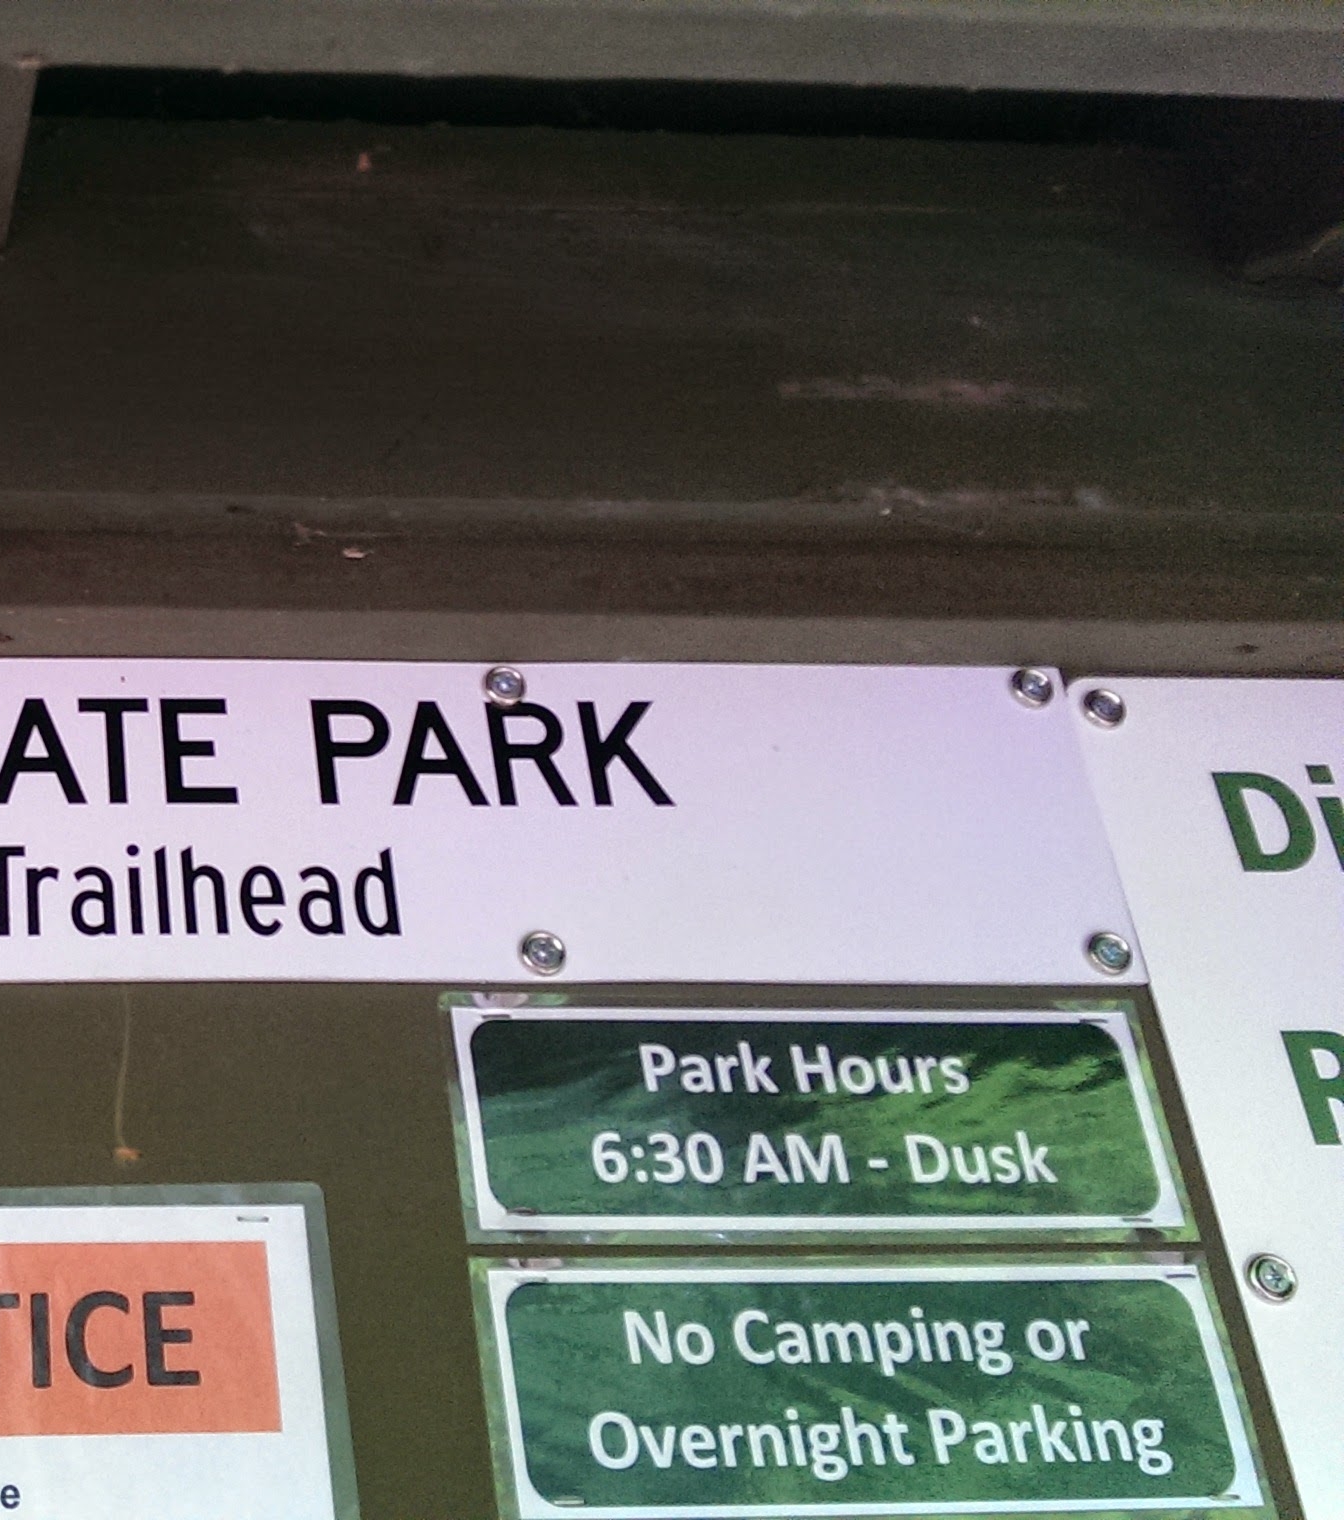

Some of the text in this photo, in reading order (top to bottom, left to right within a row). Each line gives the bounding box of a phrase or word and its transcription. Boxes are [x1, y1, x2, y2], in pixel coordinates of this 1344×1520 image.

[309, 699, 677, 807] PARK
[638, 1041, 971, 1096] Park Hours
[591, 1131, 725, 1185] 6:30
[743, 1134, 851, 1185] AM
[905, 1130, 1058, 1185] Dusk
[623, 1306, 1091, 1377] No Camping or
[587, 1404, 1174, 1482] Overnight Parking
